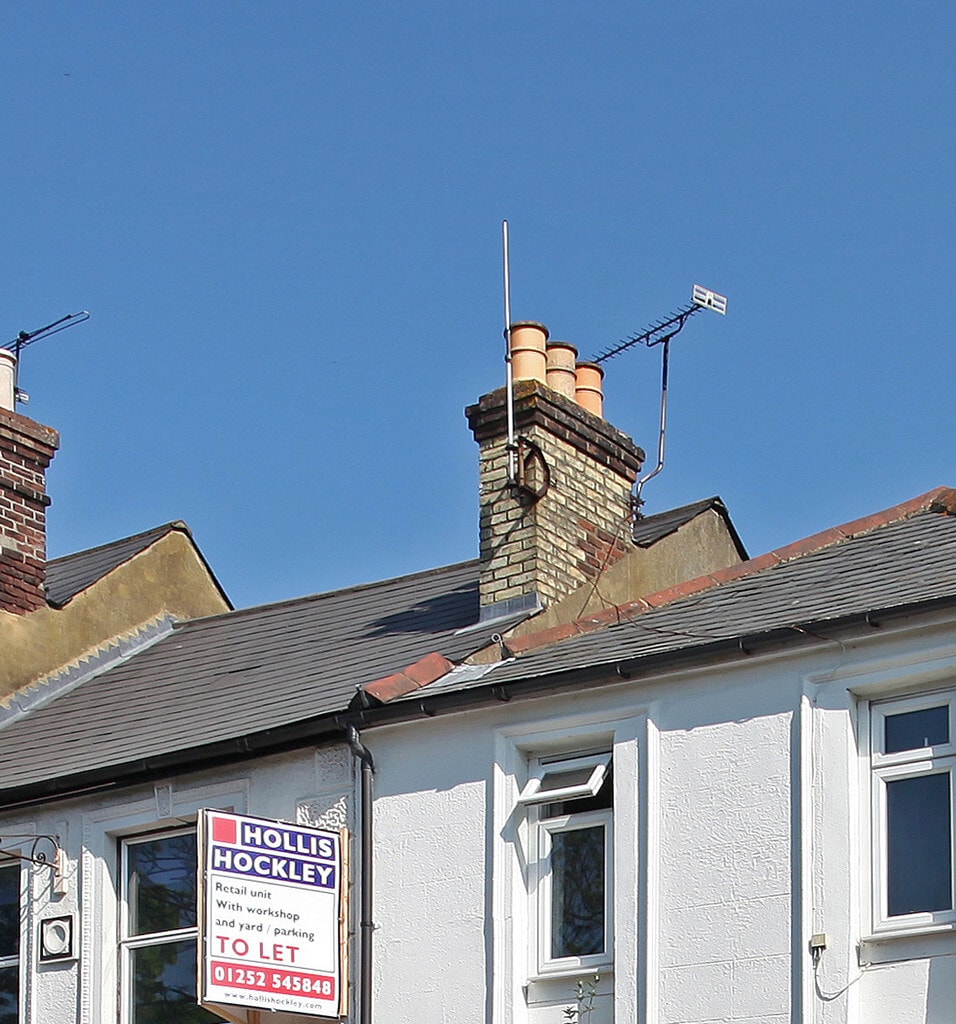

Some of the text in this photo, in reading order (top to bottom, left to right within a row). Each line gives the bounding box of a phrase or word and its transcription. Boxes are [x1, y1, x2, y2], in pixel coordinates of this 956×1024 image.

[243, 823, 334, 858] HOLLIS
[213, 848, 333, 885] HOCKLEY
[215, 882, 272, 900] Retail unit
[216, 899, 300, 921] With workshop
[215, 918, 235, 930] and
[238, 921, 263, 935] yard
[274, 926, 315, 942] parking
[216, 935, 300, 963] TO LET
[214, 966, 332, 996] 01252 545848
[224, 991, 322, 1010] www.hollishockley.com
